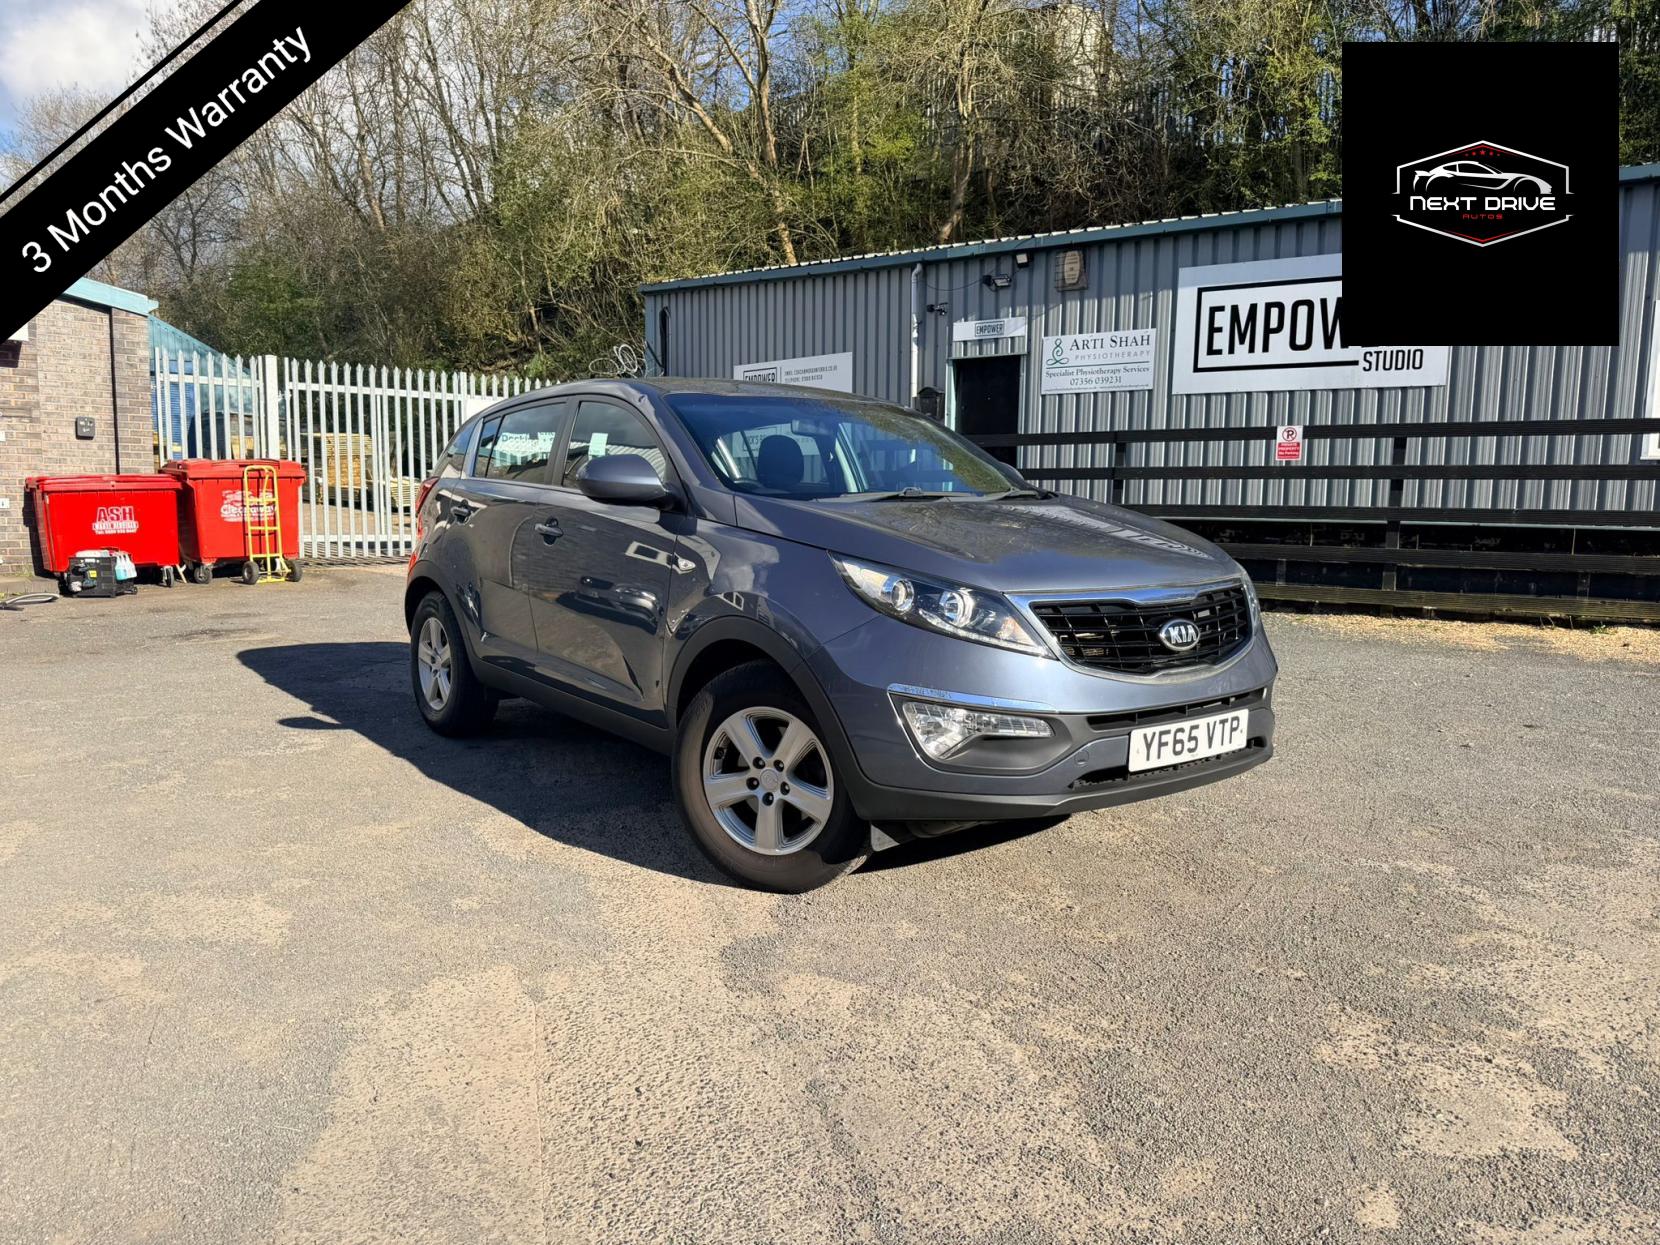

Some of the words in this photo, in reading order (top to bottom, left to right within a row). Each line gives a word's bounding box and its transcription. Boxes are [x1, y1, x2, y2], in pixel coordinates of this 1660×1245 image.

[976, 323, 1004, 335] EMPOWER
[1206, 297, 1351, 356] EMPOW
[1069, 338, 1104, 351] ARTI
[1109, 334, 1151, 349] SHAH
[1074, 350, 1151, 361] PHYSIOTHERAPY
[1362, 348, 1424, 372] STUDIO
[1045, 369, 1075, 379] Specialist
[1076, 366, 1121, 377] Physiotherapy
[1122, 365, 1150, 374] Services
[97, 506, 134, 521] ASH
[1168, 625, 1197, 645] KIA
[1142, 724, 1200, 762] YF65
[1206, 715, 1241, 750] VTP
